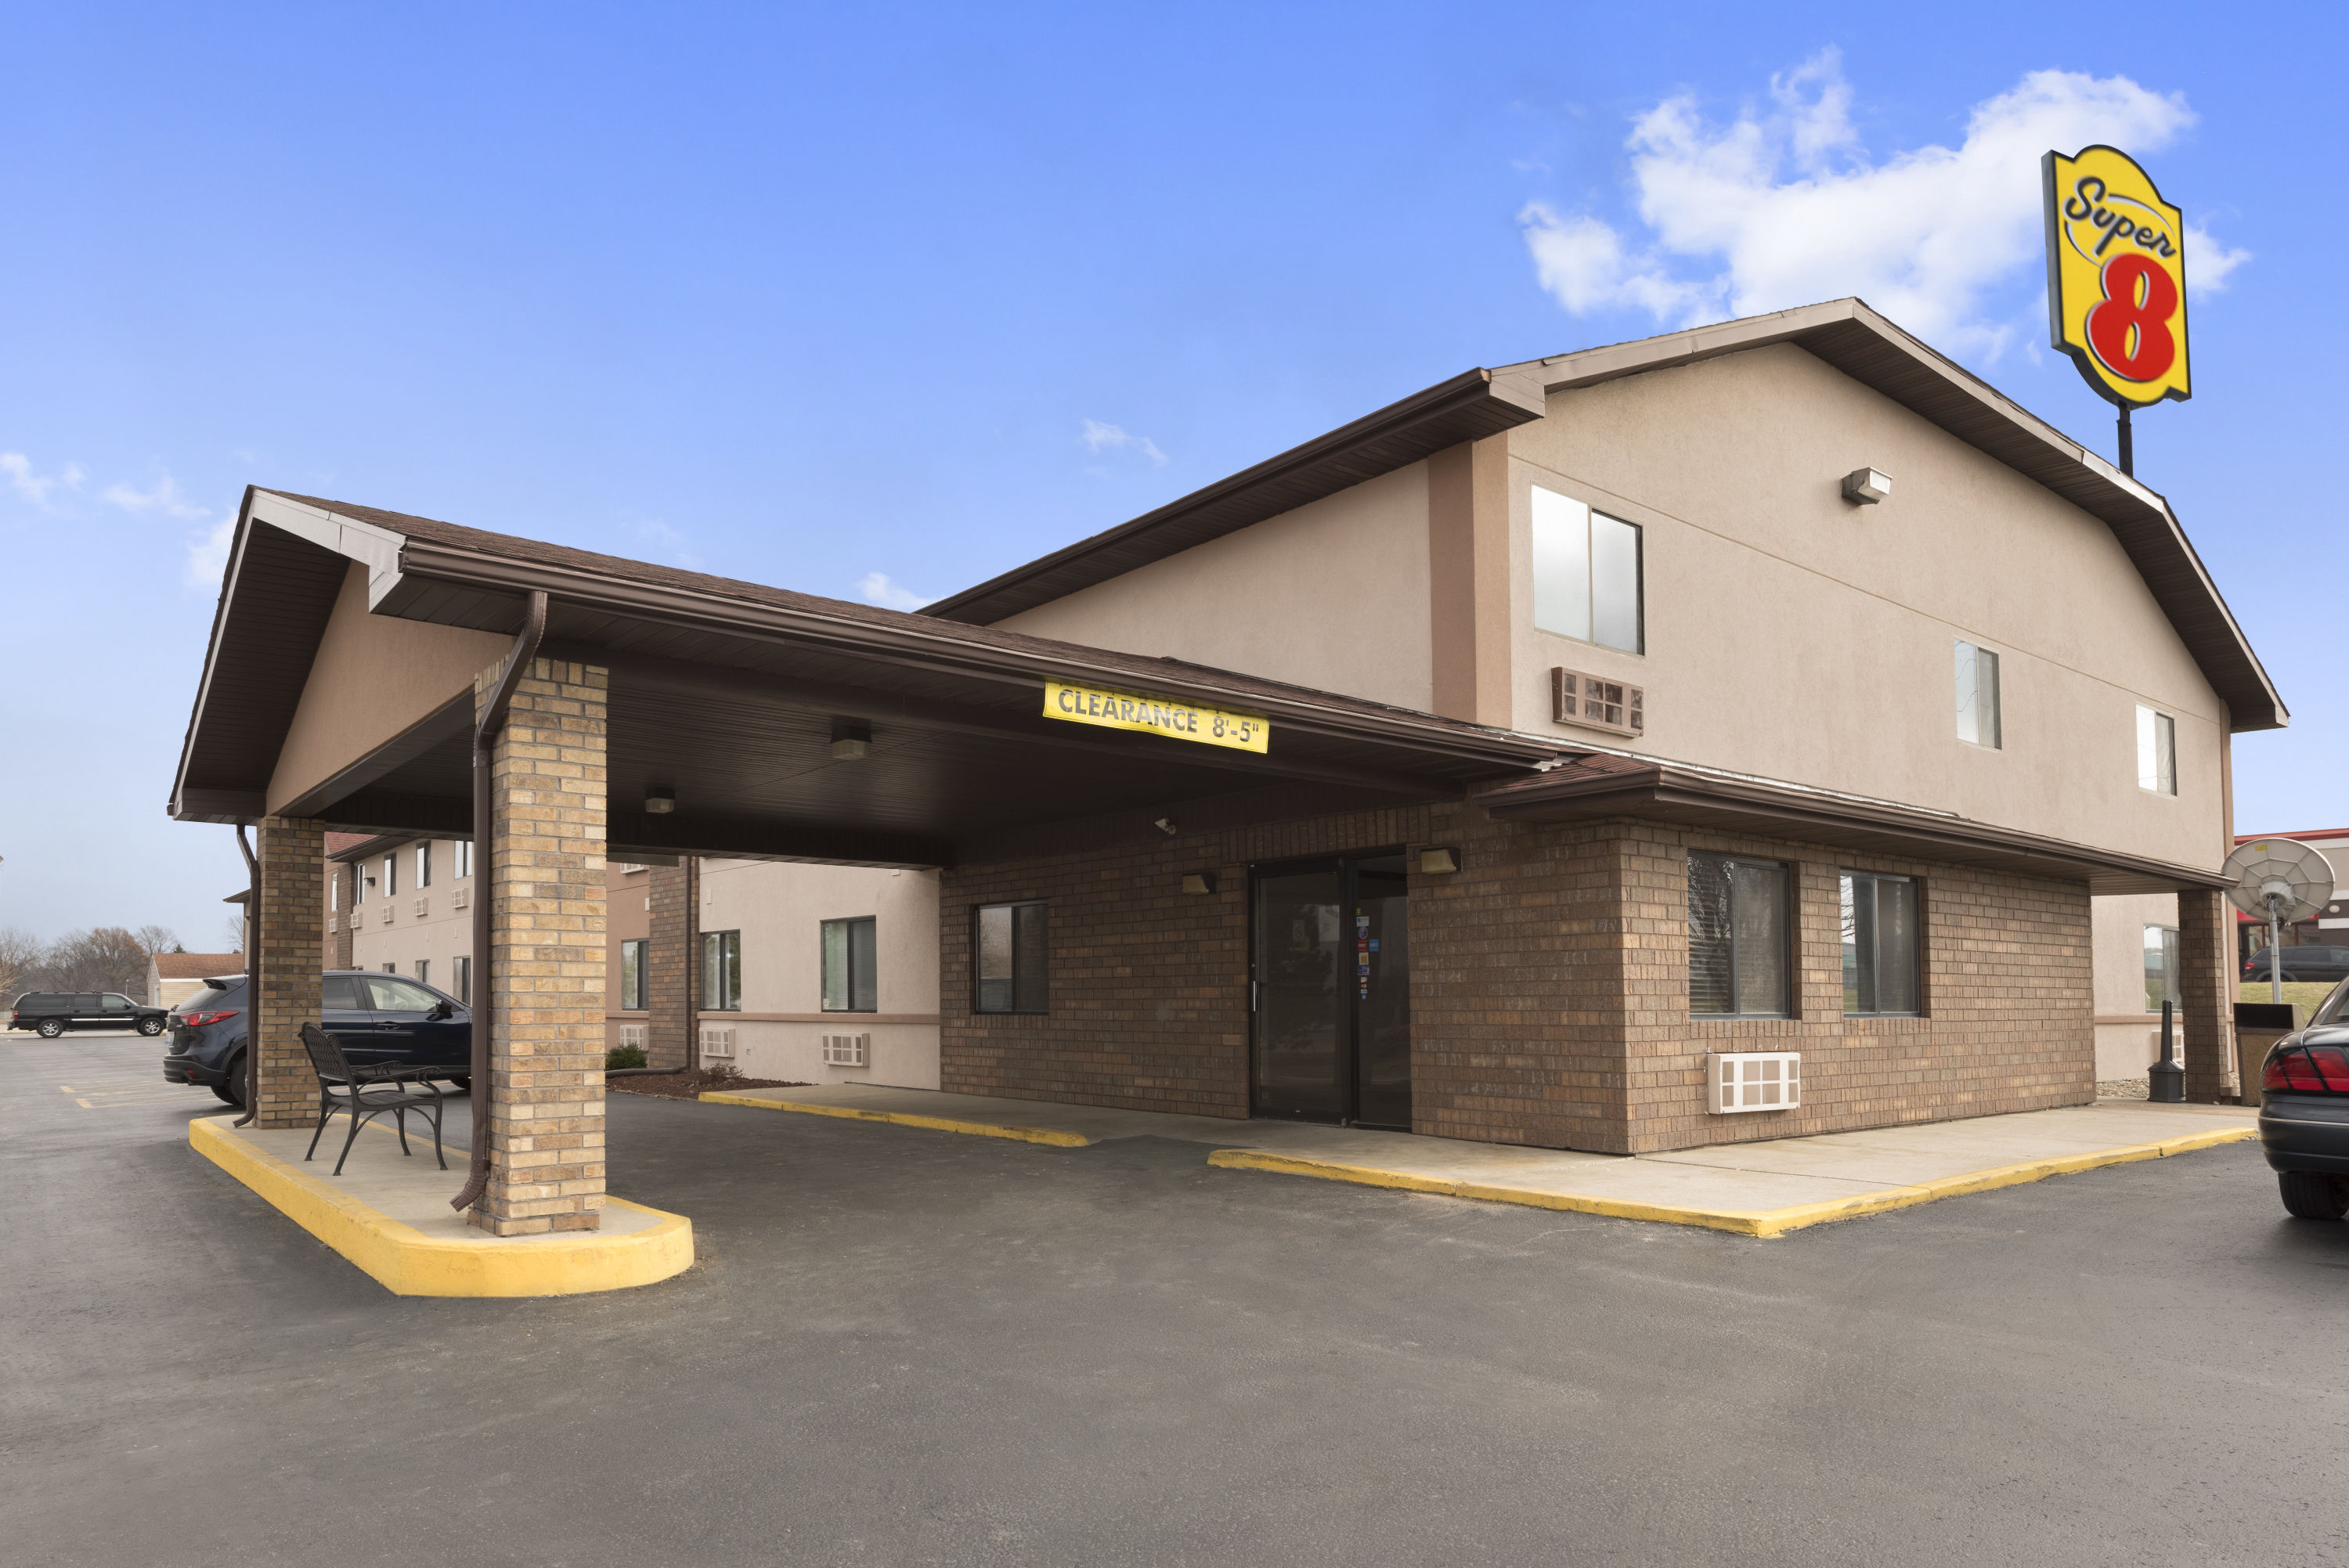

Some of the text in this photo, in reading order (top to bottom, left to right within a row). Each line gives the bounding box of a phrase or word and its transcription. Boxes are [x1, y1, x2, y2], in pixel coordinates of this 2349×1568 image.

[2063, 175, 2176, 259] Super
[2085, 252, 2178, 384] 8
[1058, 688, 1198, 734] CLEARANCE
